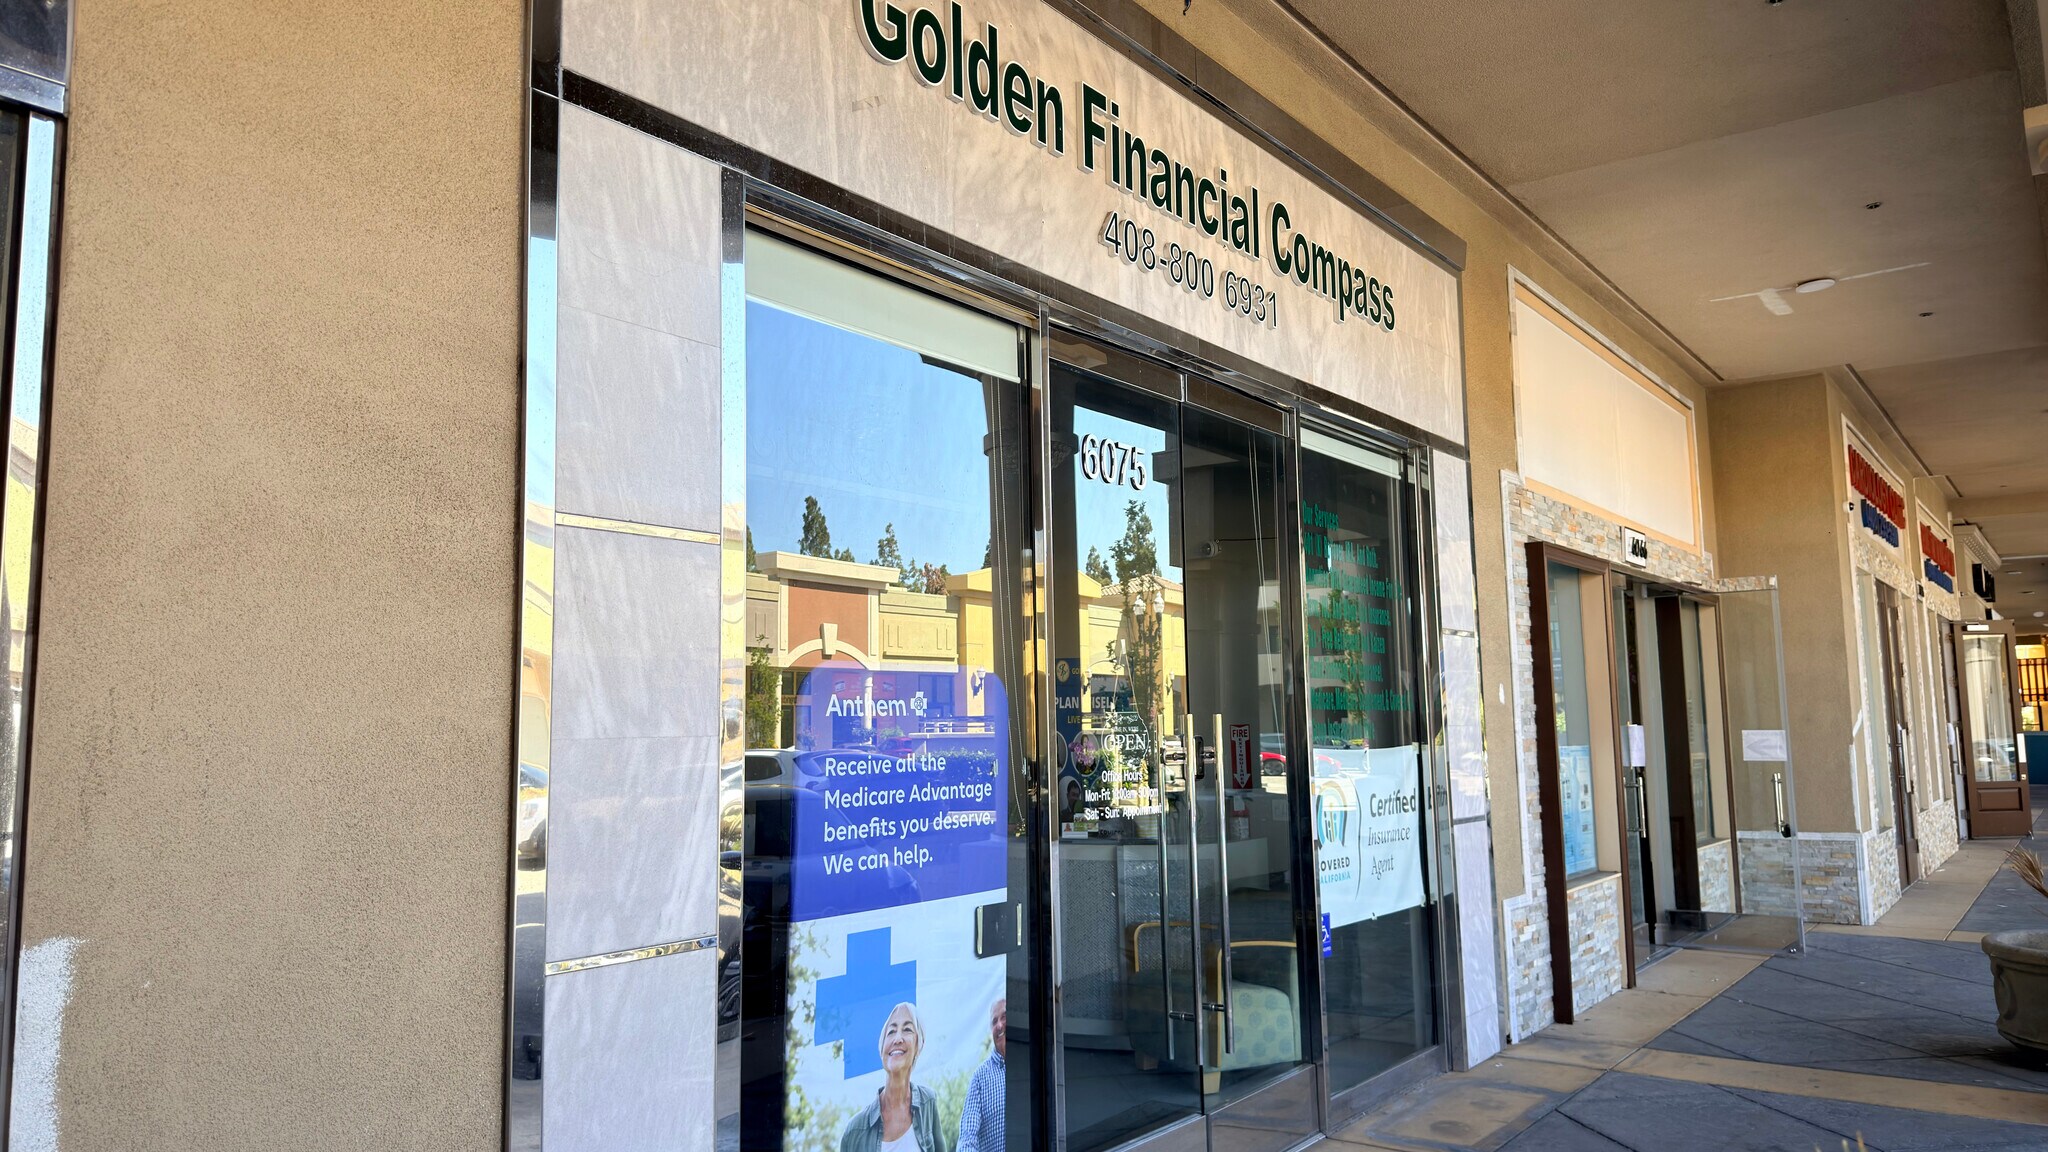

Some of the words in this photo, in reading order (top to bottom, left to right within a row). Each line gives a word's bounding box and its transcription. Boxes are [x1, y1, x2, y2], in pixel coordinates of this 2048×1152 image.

[857, 0, 1064, 157] Golden
[1078, 81, 1260, 260] Financial
[1268, 202, 1396, 332] Compass
[1100, 211, 1215, 300] 408-800
[1221, 270, 1278, 329] 6931
[1081, 433, 1147, 490] 6075
[825, 694, 907, 717] Anthem
[1104, 734, 1146, 751] OPEN
[1232, 729, 1248, 738] FIRE
[825, 757, 892, 777] Receive
[896, 754, 917, 773] all
[921, 753, 946, 771] the
[1123, 769, 1142, 781] Hours
[824, 785, 905, 809] Medicare
[909, 777, 992, 804] Advantage
[1369, 784, 1416, 818] Certified
[823, 816, 896, 843] benefits
[900, 816, 929, 840] you
[933, 811, 995, 831] deserve.
[1367, 824, 1410, 847] Insurance
[823, 853, 853, 875] We
[858, 852, 889, 871] can
[894, 844, 933, 869] help.
[1319, 856, 1350, 872] OVERED
[1371, 855, 1394, 881] Agent
[1320, 871, 1351, 885] ALIFORNIA
